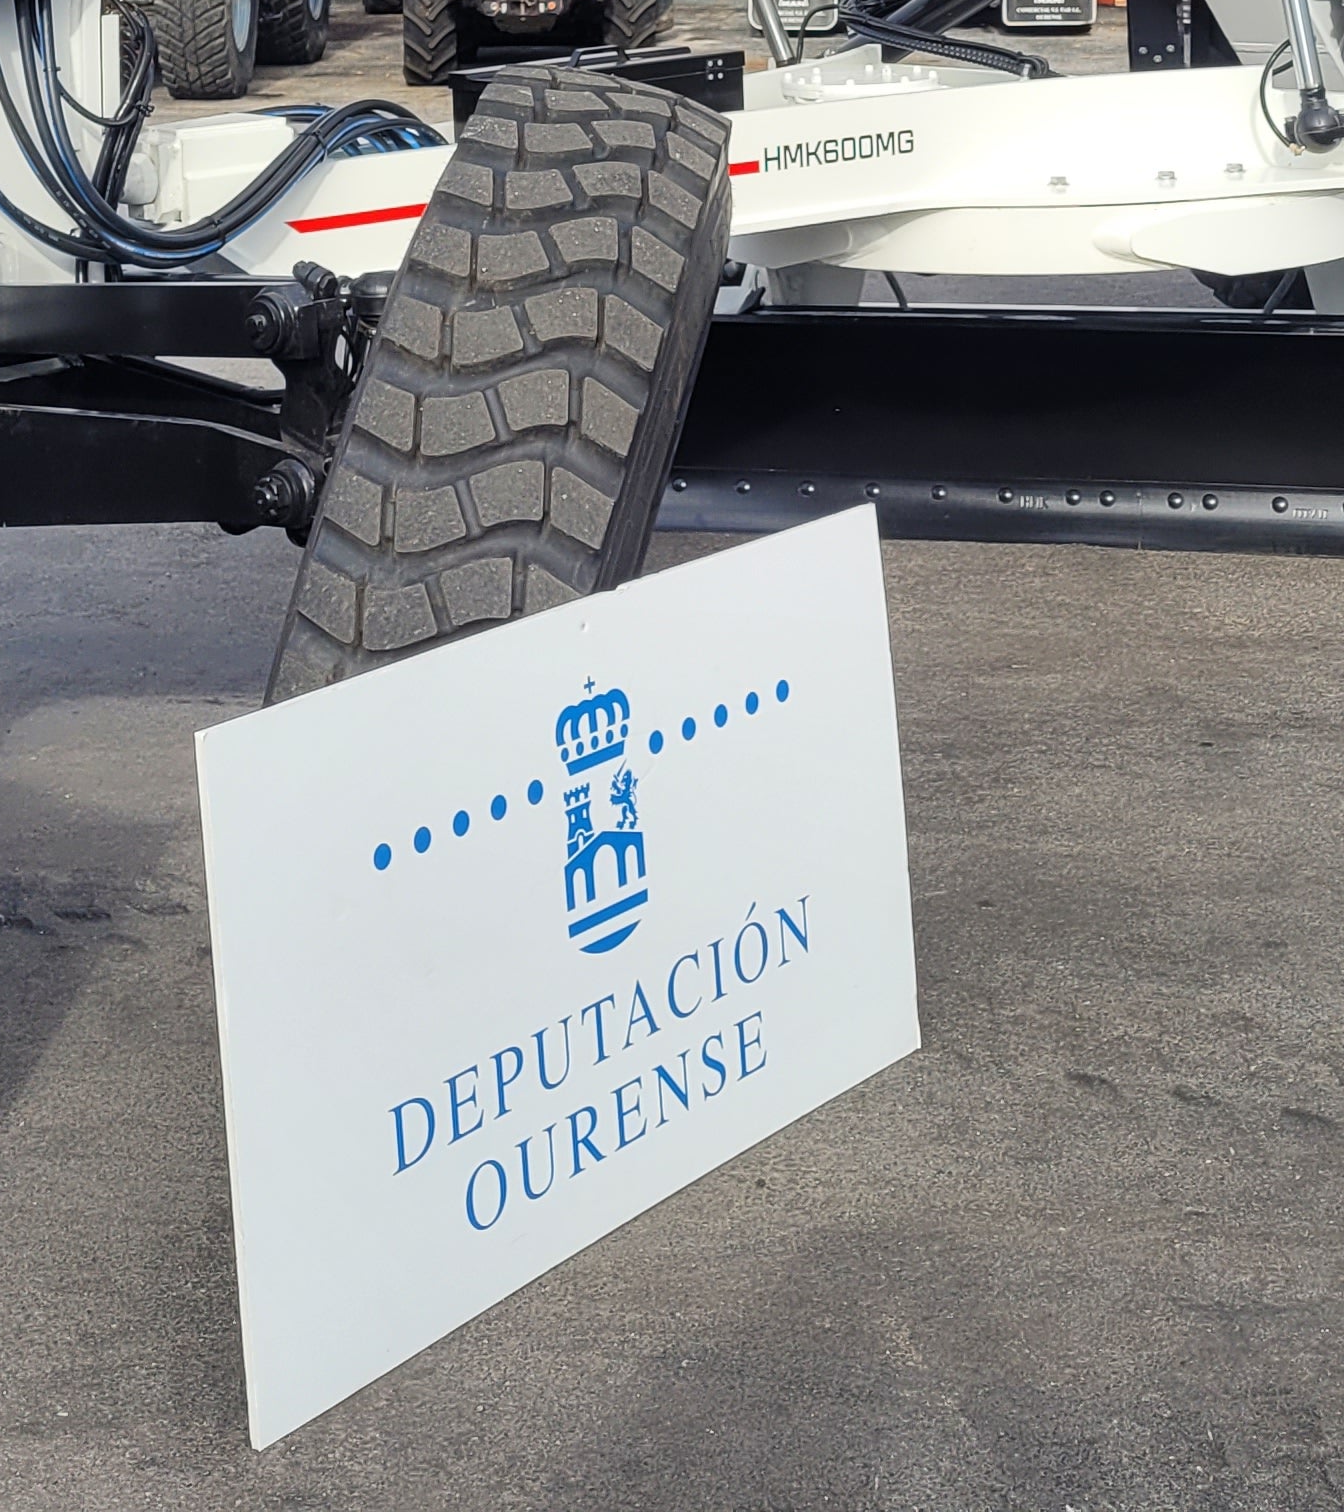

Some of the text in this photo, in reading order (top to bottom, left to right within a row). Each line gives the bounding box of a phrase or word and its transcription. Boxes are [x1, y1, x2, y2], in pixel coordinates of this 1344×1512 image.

[763, 129, 915, 173] HMK600MG
[387, 894, 811, 1177] DEPUTACIÓN
[464, 1009, 769, 1232] OURENSE
